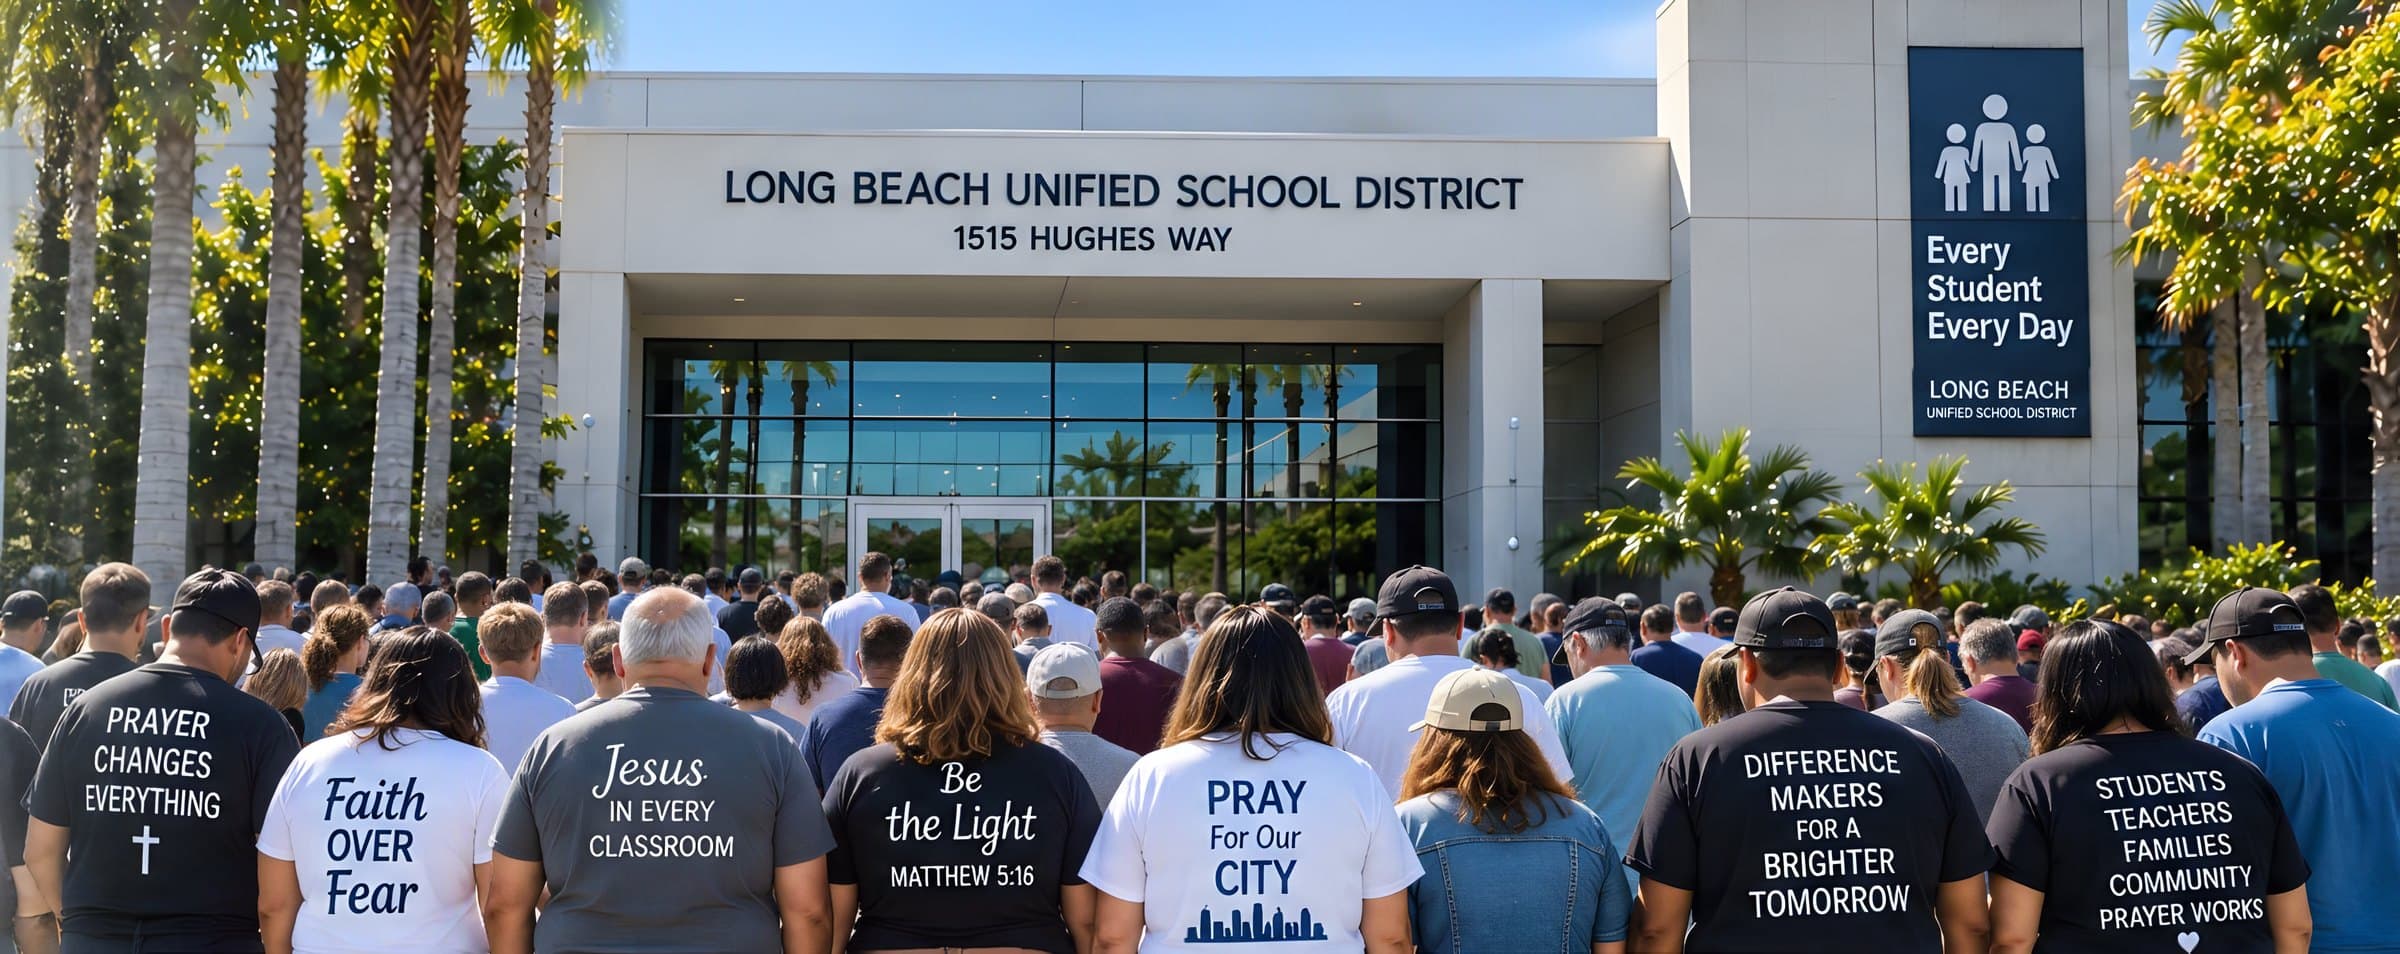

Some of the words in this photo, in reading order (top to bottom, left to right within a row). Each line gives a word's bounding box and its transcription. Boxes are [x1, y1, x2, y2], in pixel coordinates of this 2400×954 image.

[727, 171, 835, 203] LONG
[854, 172, 988, 205] BEACH
[1007, 173, 1159, 206] UNIFIED
[1177, 175, 1340, 208] SCHOOL
[1357, 177, 1523, 209] DISTRICT
[954, 226, 1016, 250] 1515
[1031, 226, 1155, 251] HUGHES
[1168, 227, 1232, 251] WAY
[1928, 236, 2010, 270] Every
[1929, 274, 2042, 302] Student
[1929, 312, 2009, 346] Every
[2020, 312, 2073, 347] Day
[1931, 381, 1988, 399] LONG
[1999, 381, 2068, 399] BEACH
[1927, 407, 1973, 418] UNIFIED
[1976, 407, 2023, 418] SCHOOL
[2027, 407, 2077, 418] DISTRICT
[107, 707, 209, 739] PRAYER
[95, 745, 212, 778] CHANGES
[1745, 749, 1900, 778] DIFFERENCE
[940, 762, 981, 793] Be
[2096, 771, 2225, 799] STUDENTS
[86, 785, 220, 818] EVERYTHING
[325, 777, 427, 821] Faith
[611, 801, 631, 821] IN
[642, 800, 714, 821] EVERY
[1208, 780, 1306, 815] PRAY
[1771, 783, 1882, 811] MAKERS
[886, 801, 941, 841] the
[954, 801, 1036, 855] Light
[1797, 819, 1838, 840] FOR
[1846, 817, 1861, 838] A
[2104, 802, 2232, 830] TEACHERS
[328, 829, 413, 862] OVER
[590, 835, 733, 857] CLASSROOM
[1211, 825, 1249, 849] For
[1257, 825, 1301, 848] Our
[2124, 834, 2231, 862] FAMILIES
[892, 865, 990, 887] MATTHEW
[998, 865, 1033, 885] 5:16
[1216, 860, 1296, 895] CITY
[1765, 848, 1895, 879] BRIGHTER
[327, 870, 418, 914] Fear
[2110, 866, 2251, 896] COMMUNITY
[1749, 885, 1909, 917] TOMORROW
[2100, 904, 2185, 929] PRAYER
[2191, 899, 2263, 922] WORKS
